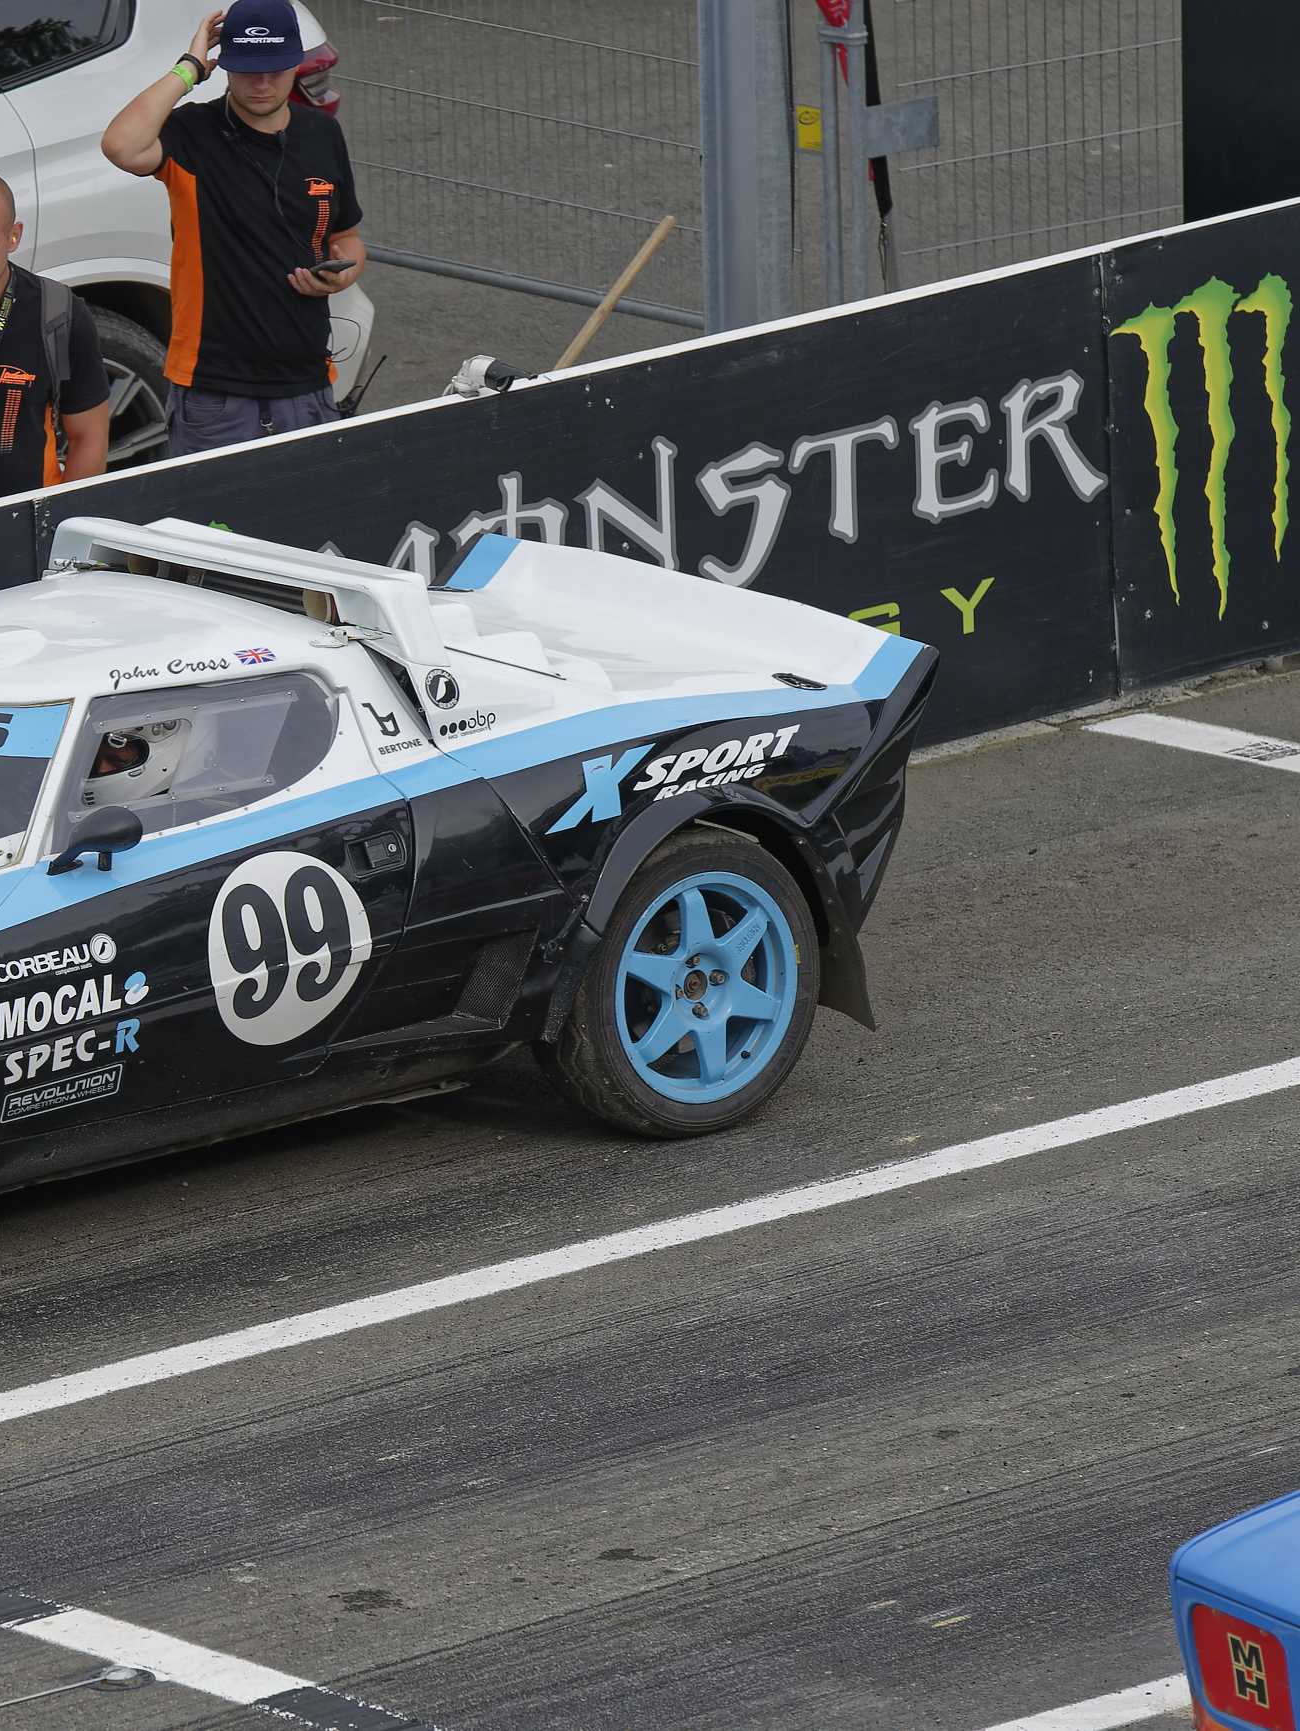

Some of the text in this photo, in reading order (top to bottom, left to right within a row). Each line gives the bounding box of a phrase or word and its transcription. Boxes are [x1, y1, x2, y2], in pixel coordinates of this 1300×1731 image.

[317, 368, 1108, 594] ONSTER
[109, 656, 232, 690] John Cross
[467, 709, 496, 731] obp
[378, 738, 423, 756] BERTONE
[545, 723, 801, 836] X SPORT
[653, 763, 765, 802] RACING
[221, 865, 353, 1020] 99
[3, 1017, 141, 1086] SPEC-R
[8, 1070, 117, 1110] REVOLUTION
